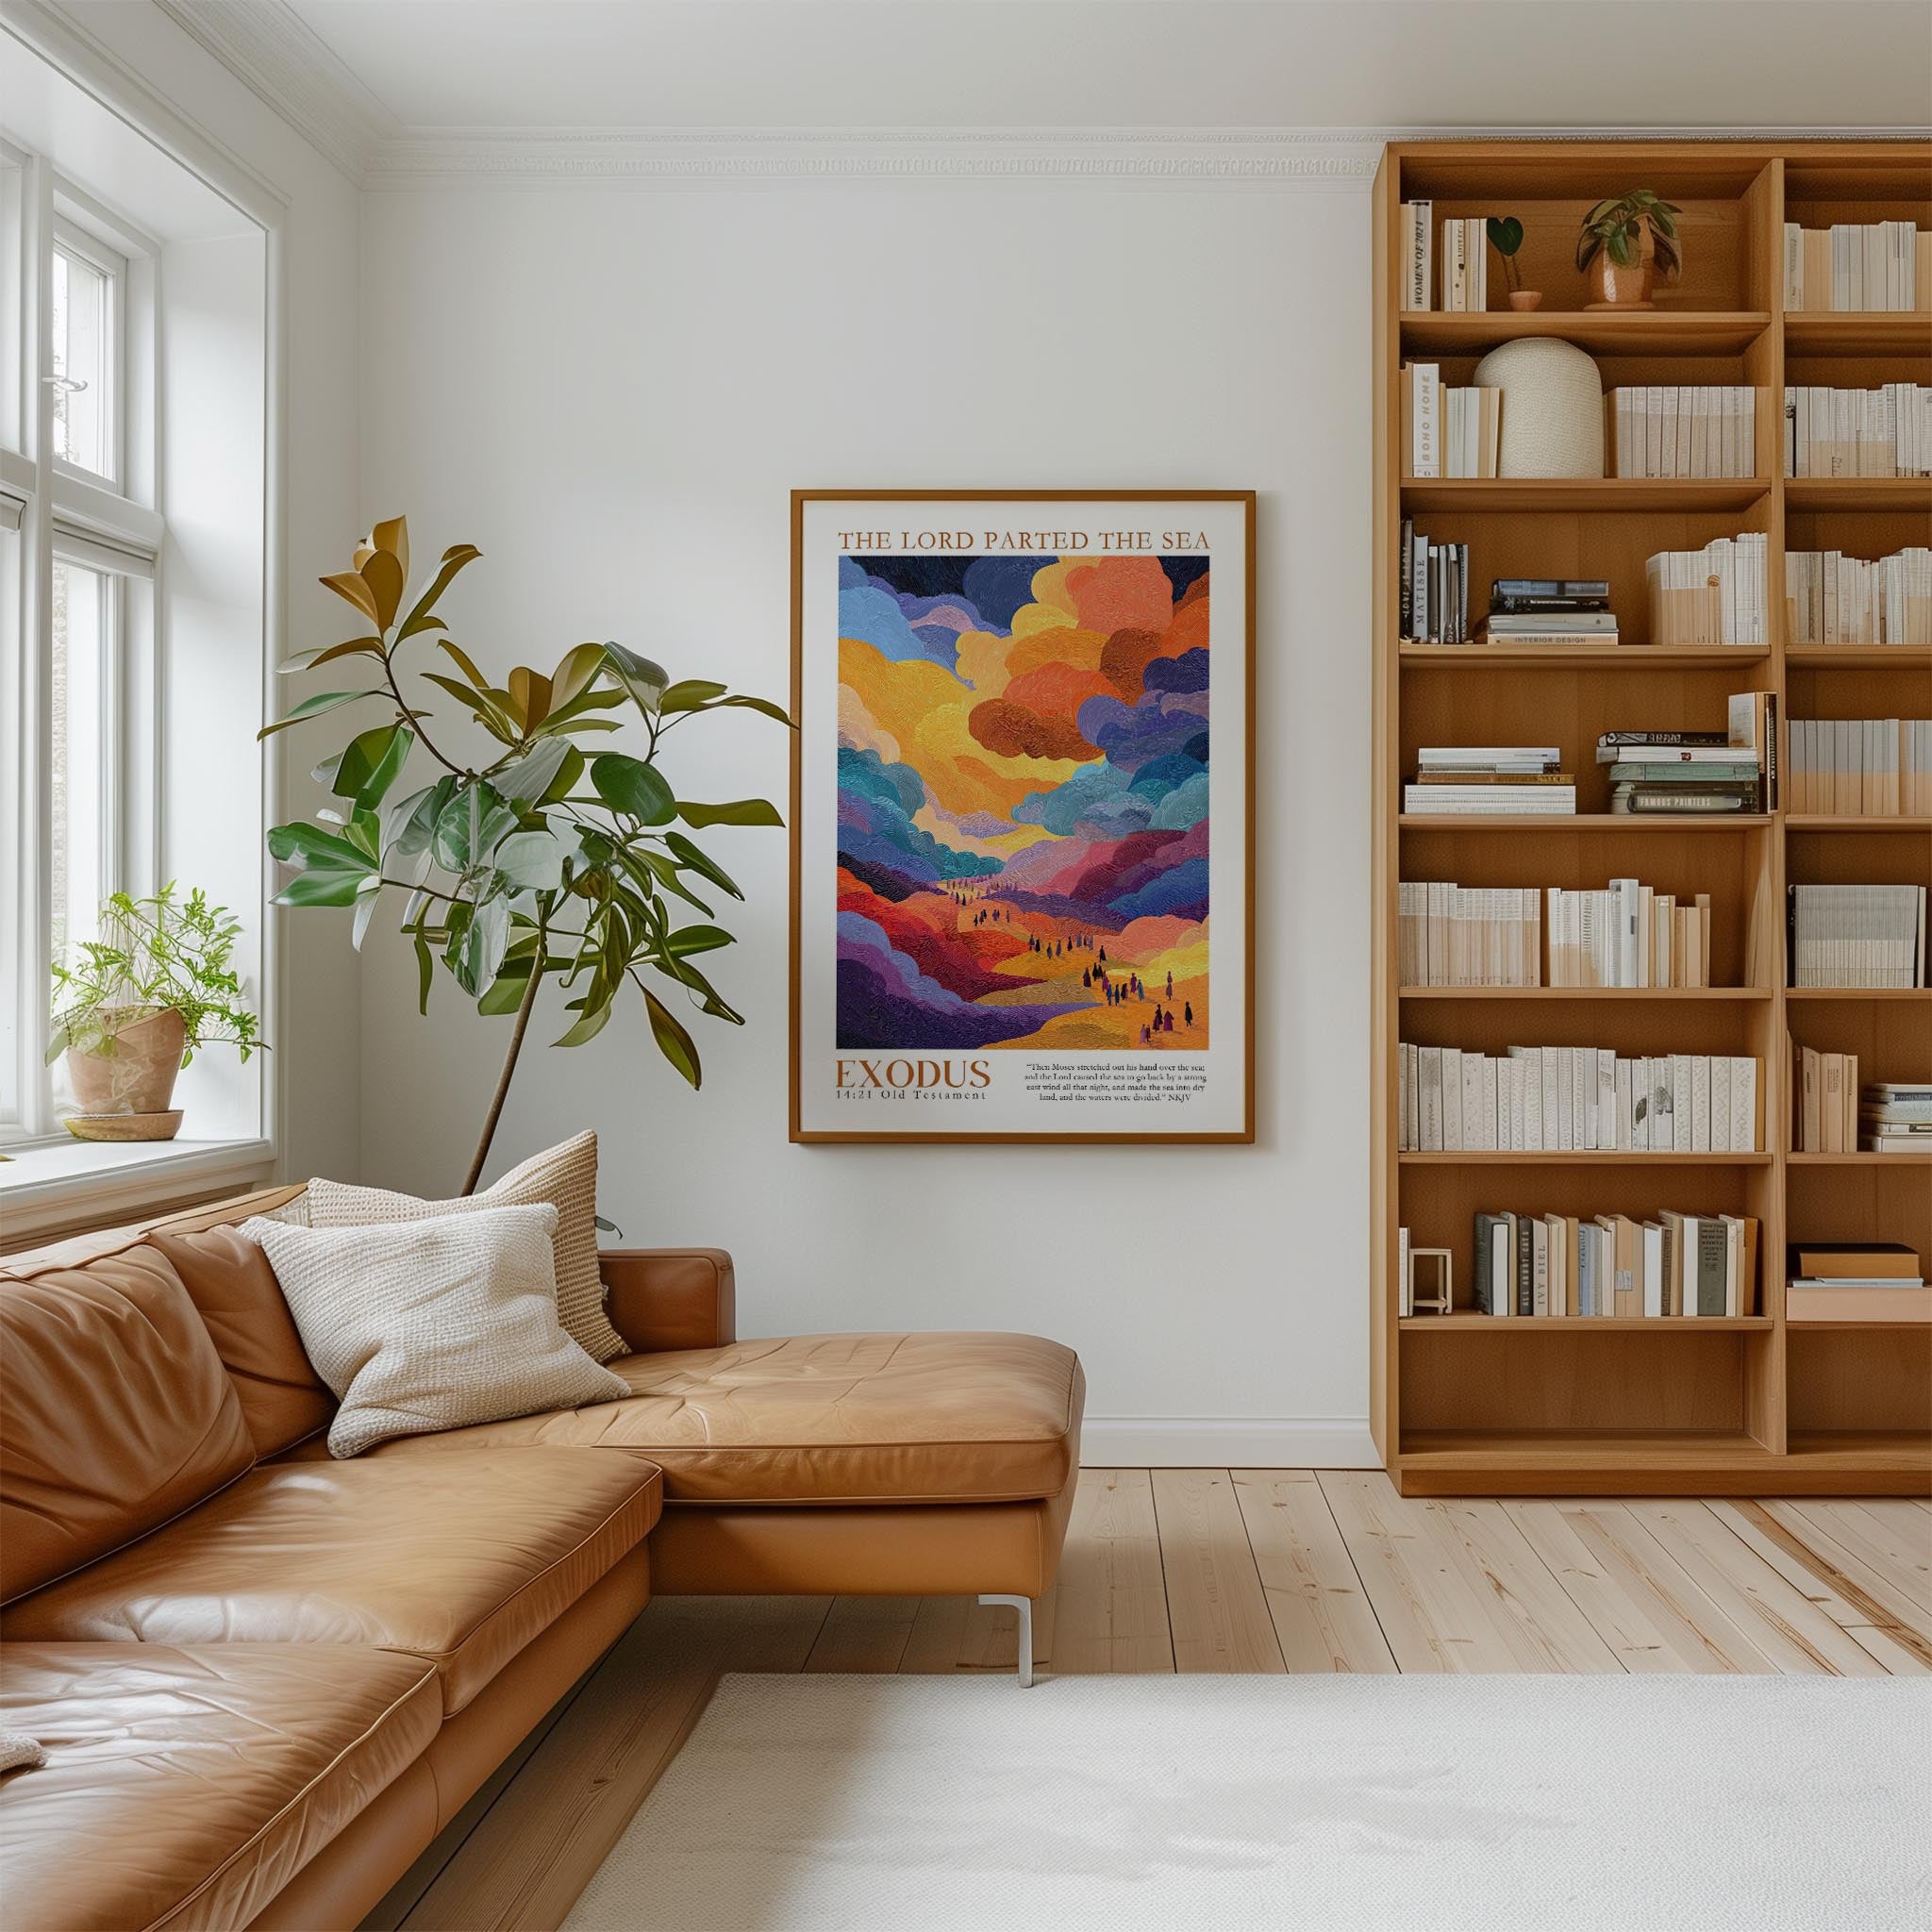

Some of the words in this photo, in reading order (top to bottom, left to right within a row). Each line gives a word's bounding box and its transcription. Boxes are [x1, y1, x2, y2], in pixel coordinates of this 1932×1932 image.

[1415, 221, 1424, 243] 2024
[1415, 244, 1424, 260] OF
[1414, 263, 1424, 305] WOMEN
[1422, 375, 1430, 415] HOME
[1422, 422, 1430, 461] BOHO
[838, 531, 891, 550] THE
[901, 531, 974, 550] LORD
[984, 531, 1089, 550] PARTED
[1098, 531, 1153, 550] THE
[1162, 531, 1210, 550] SEA
[1416, 559, 1425, 624] MATISSE
[1640, 798, 1671, 807] FAMOUS
[1674, 798, 1710, 807] PAINTERS
[836, 1059, 991, 1088] EXODUS
[1166, 1074, 1175, 1083] by
[1184, 1074, 1207, 1083] strong
[836, 1090, 872, 1099] 14:21
[881, 1090, 906, 1099] Old
[913, 1090, 986, 1099] Testament
[1168, 1093, 1192, 1103] NKJV
[1192, 1084, 1206, 1092] dry
[1522, 1231, 1530, 1252] CATS
[1538, 1245, 1546, 1274] BIEL
[1522, 1258, 1530, 1285] ABOUT
[1522, 1291, 1530, 1307] ALL
[1538, 1283, 1546, 1305] IVY
